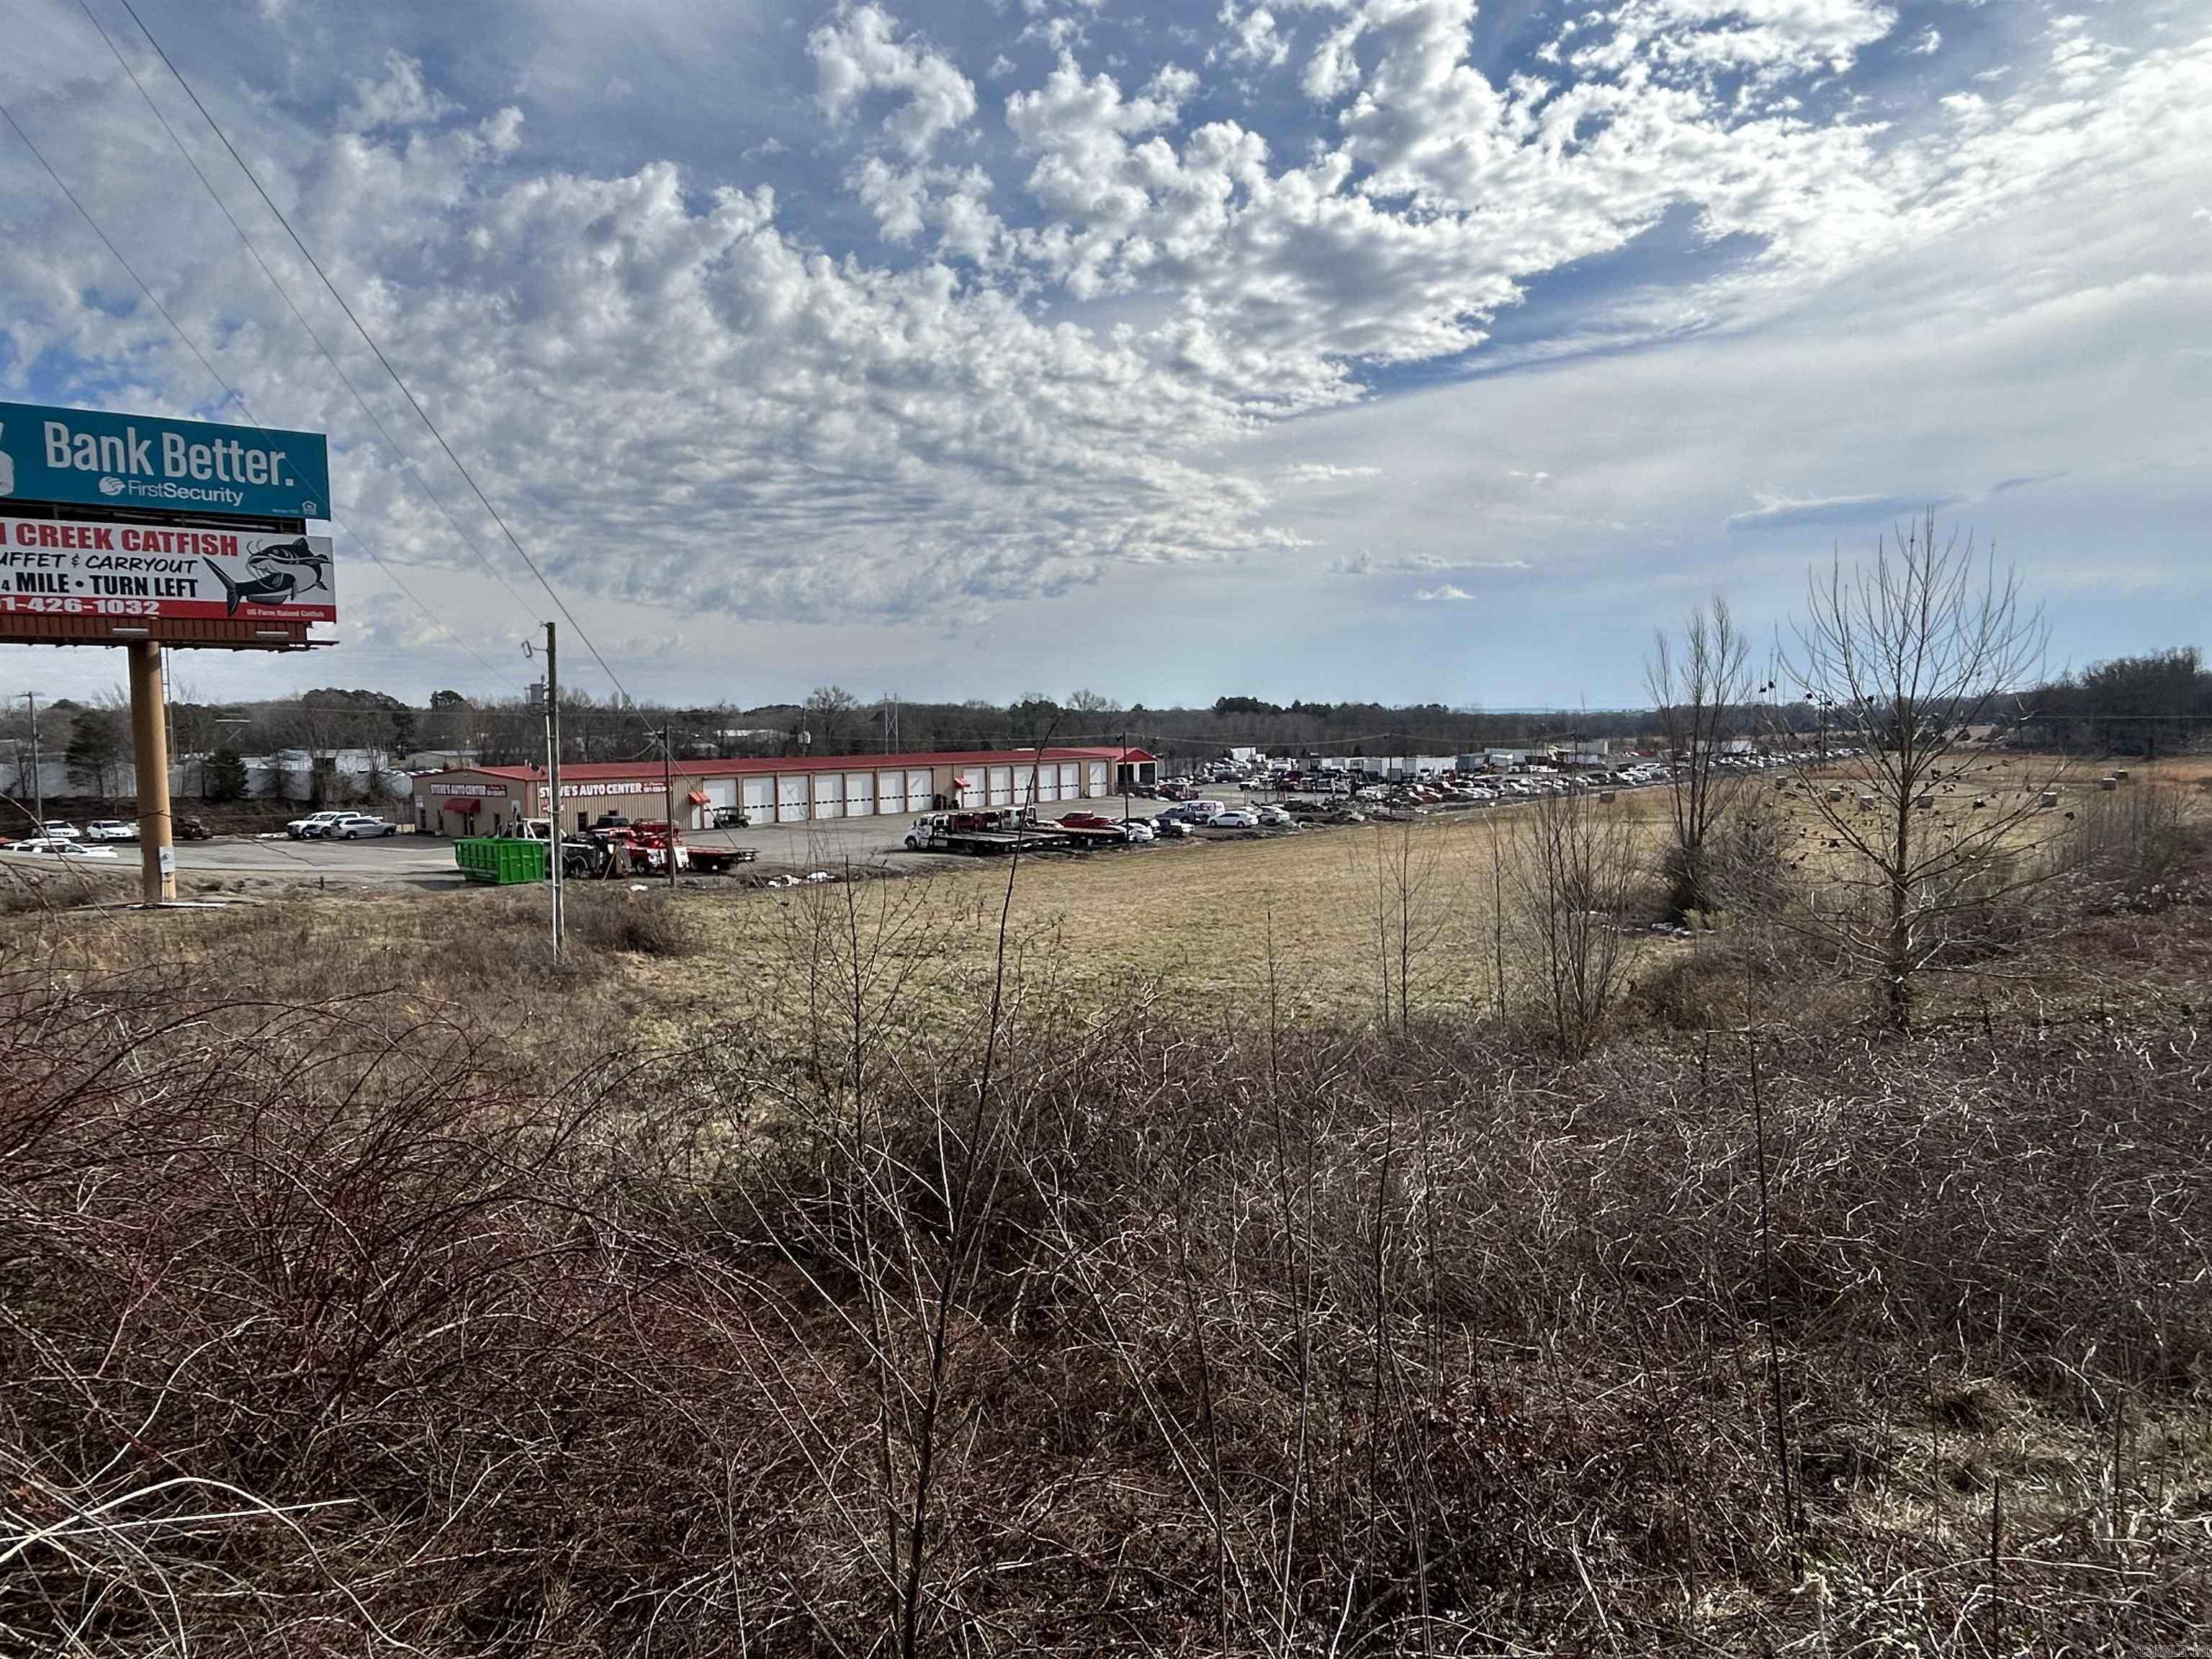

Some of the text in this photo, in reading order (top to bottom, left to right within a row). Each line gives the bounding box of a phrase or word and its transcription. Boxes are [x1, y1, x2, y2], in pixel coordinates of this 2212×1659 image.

[43, 421, 294, 487] Bank Better.
[127, 478, 244, 506] FirstSecurity
[16, 523, 115, 550] CREEK
[122, 529, 238, 557] CATFISH
[85, 554, 198, 574] CARRYOUT
[16, 572, 70, 594] MILE
[88, 575, 149, 597] TURN
[153, 577, 198, 598] LEFT
[0, 596, 161, 616] 1-426-1032
[539, 784, 578, 798] STVE'S
[579, 783, 606, 796] AUTO
[606, 782, 642, 795] CENTER
